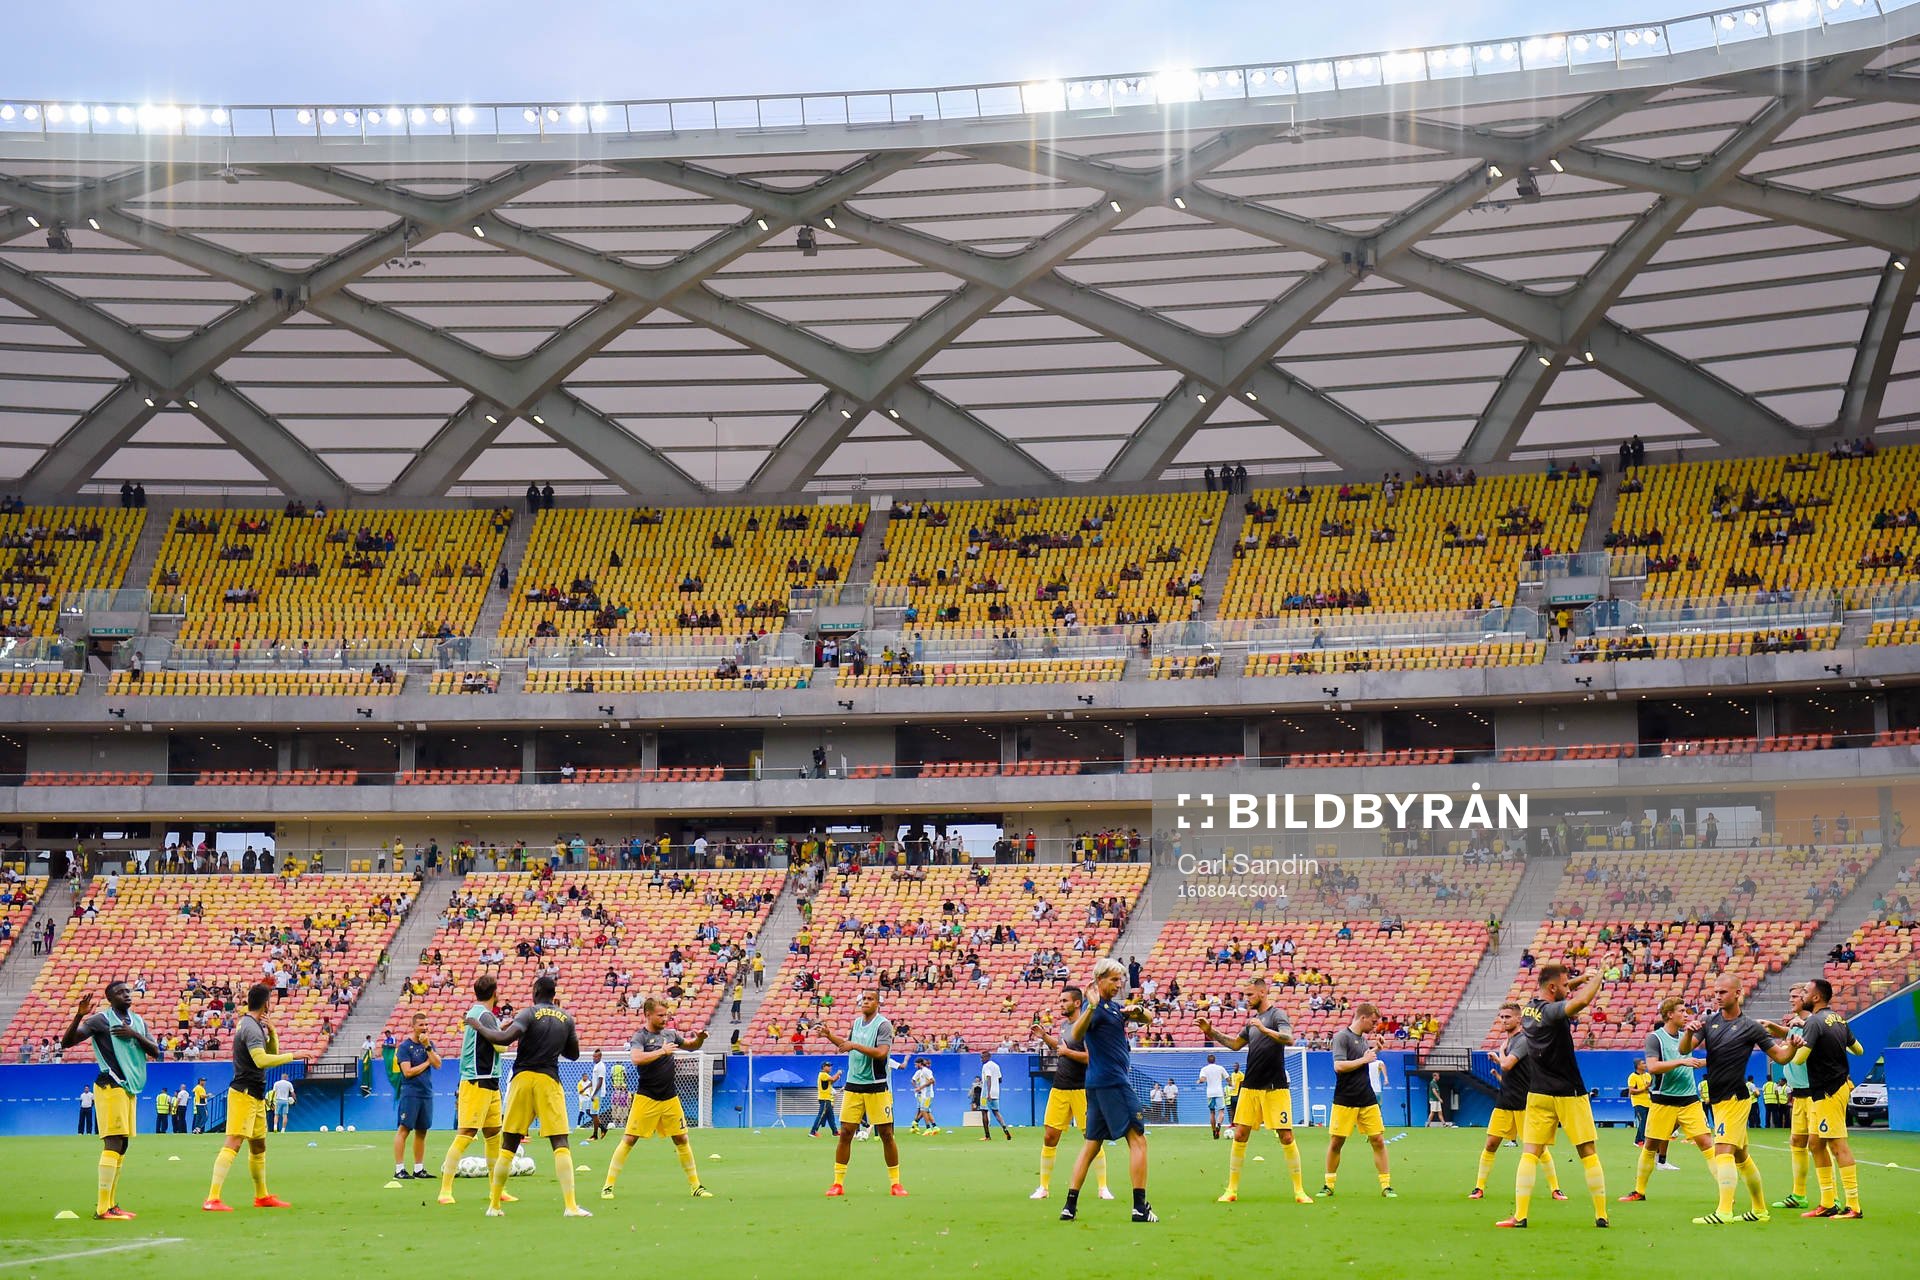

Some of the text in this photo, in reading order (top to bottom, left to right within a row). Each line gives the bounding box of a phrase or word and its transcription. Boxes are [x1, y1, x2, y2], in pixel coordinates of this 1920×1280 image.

[884, 1106, 891, 1118] 9
[1280, 1111, 1288, 1124] 3
[1819, 1118, 1829, 1133] 6
